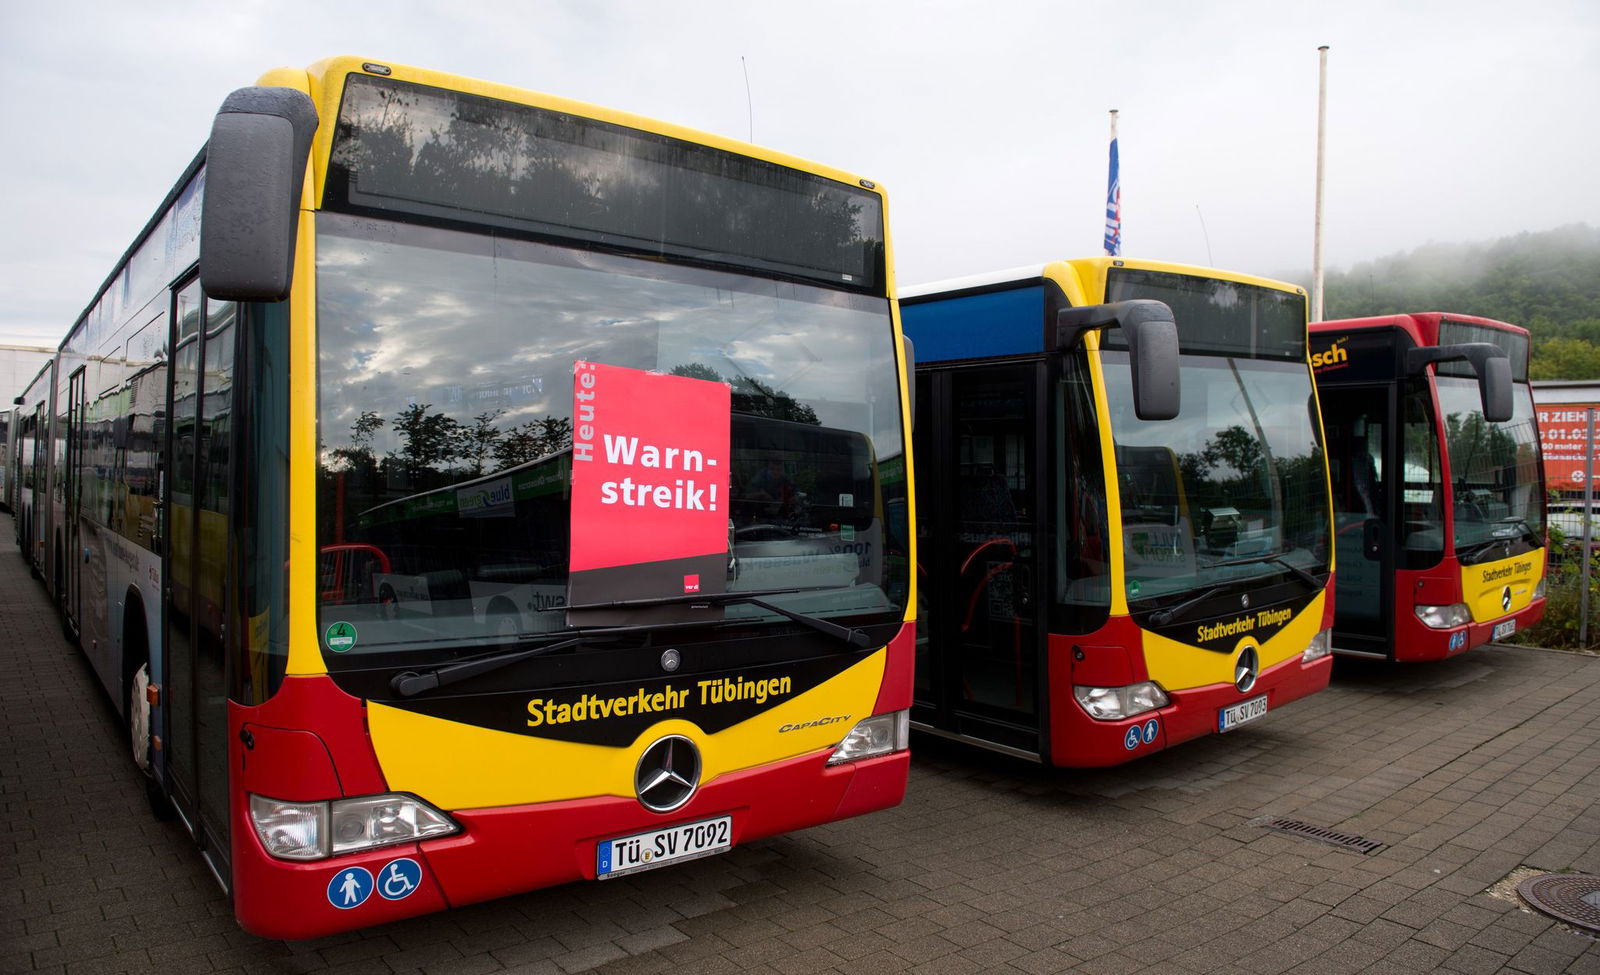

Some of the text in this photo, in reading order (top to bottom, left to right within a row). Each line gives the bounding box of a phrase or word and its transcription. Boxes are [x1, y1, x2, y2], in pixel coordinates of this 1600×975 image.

[574, 363, 596, 462] Heute:
[1552, 411, 1600, 422] ZIEH
[603, 433, 717, 472] Warn-
[601, 477, 717, 511] streik!
[337, 624, 346, 637] 4
[1197, 608, 1291, 643] Stadtverkehr Tübingen
[527, 674, 792, 727] Stadtverkehr Tübingen
[654, 831, 679, 858] SV
[683, 821, 728, 852] 7092
